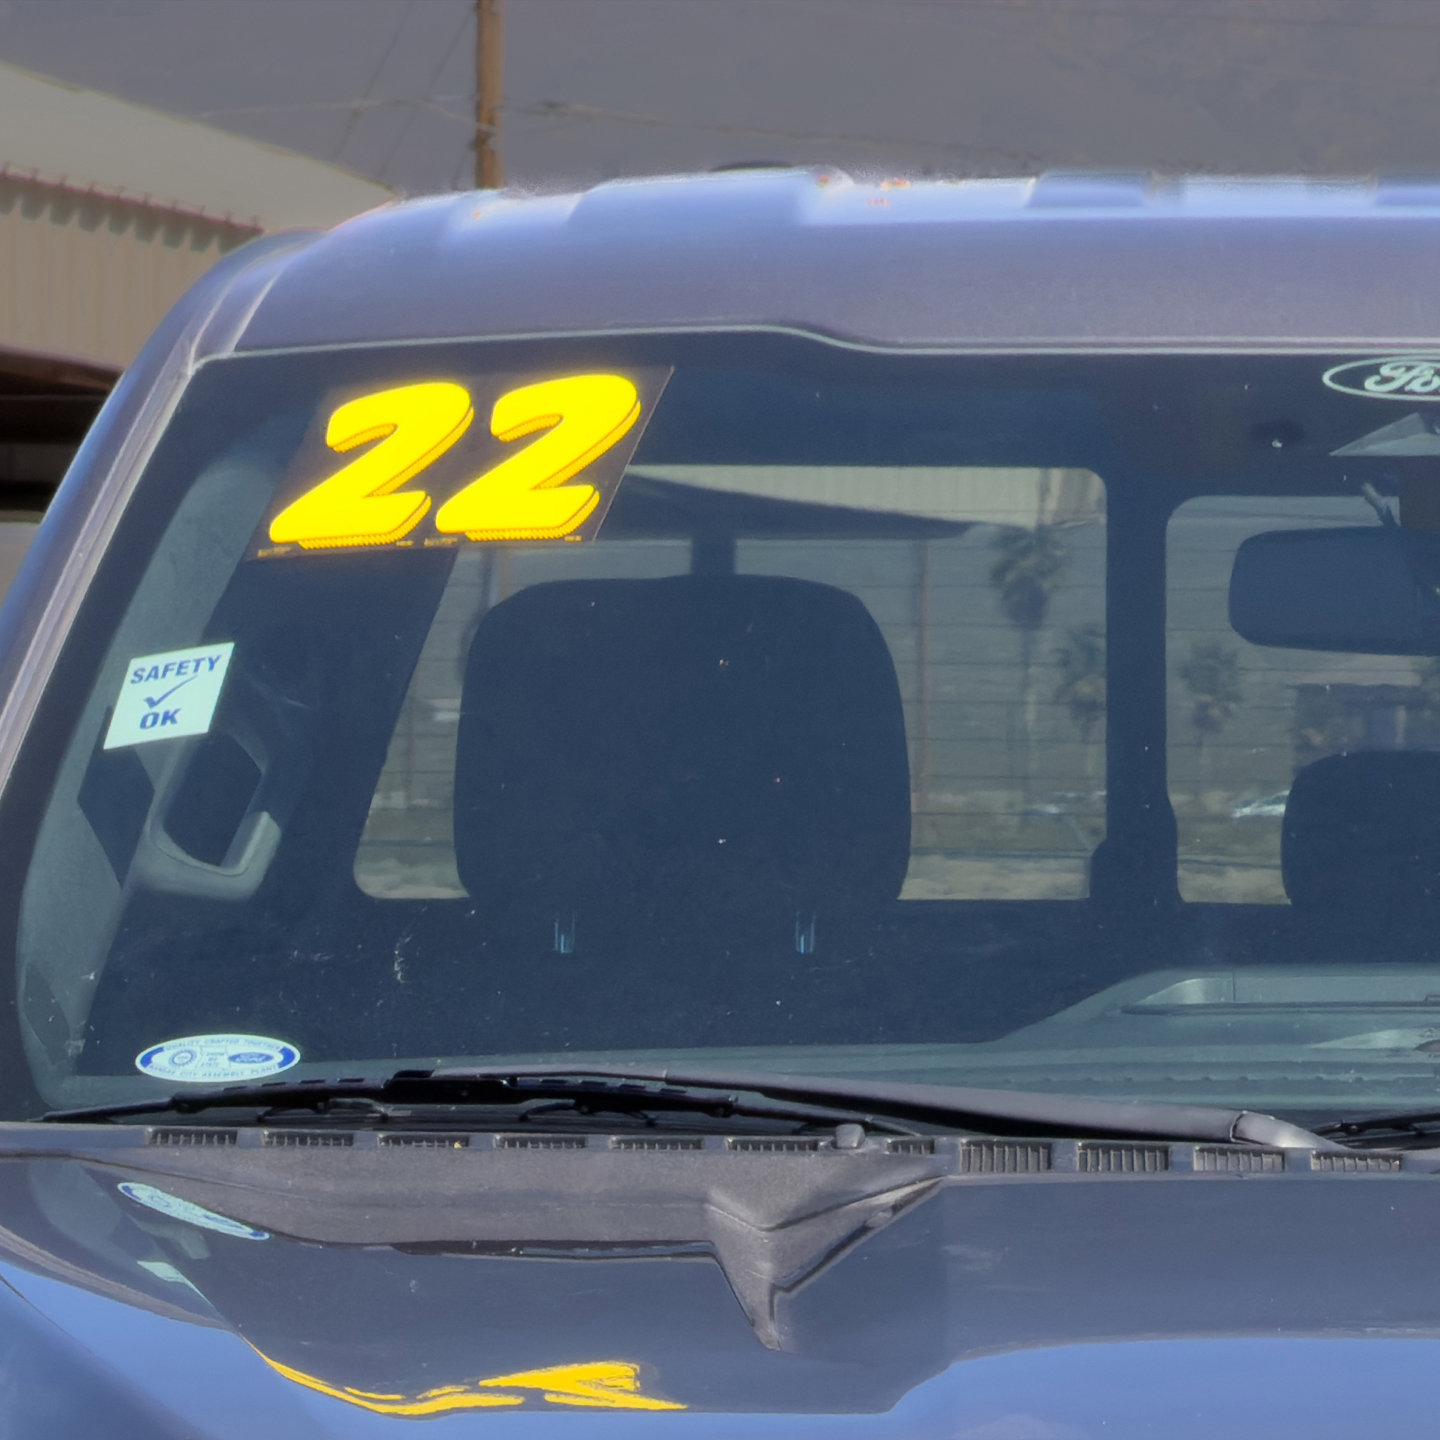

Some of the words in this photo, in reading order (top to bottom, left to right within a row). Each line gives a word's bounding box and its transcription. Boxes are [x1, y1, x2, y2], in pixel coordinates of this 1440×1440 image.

[269, 374, 641, 549] 22
[130, 655, 222, 684] SAFETY
[140, 708, 181, 729] OK
